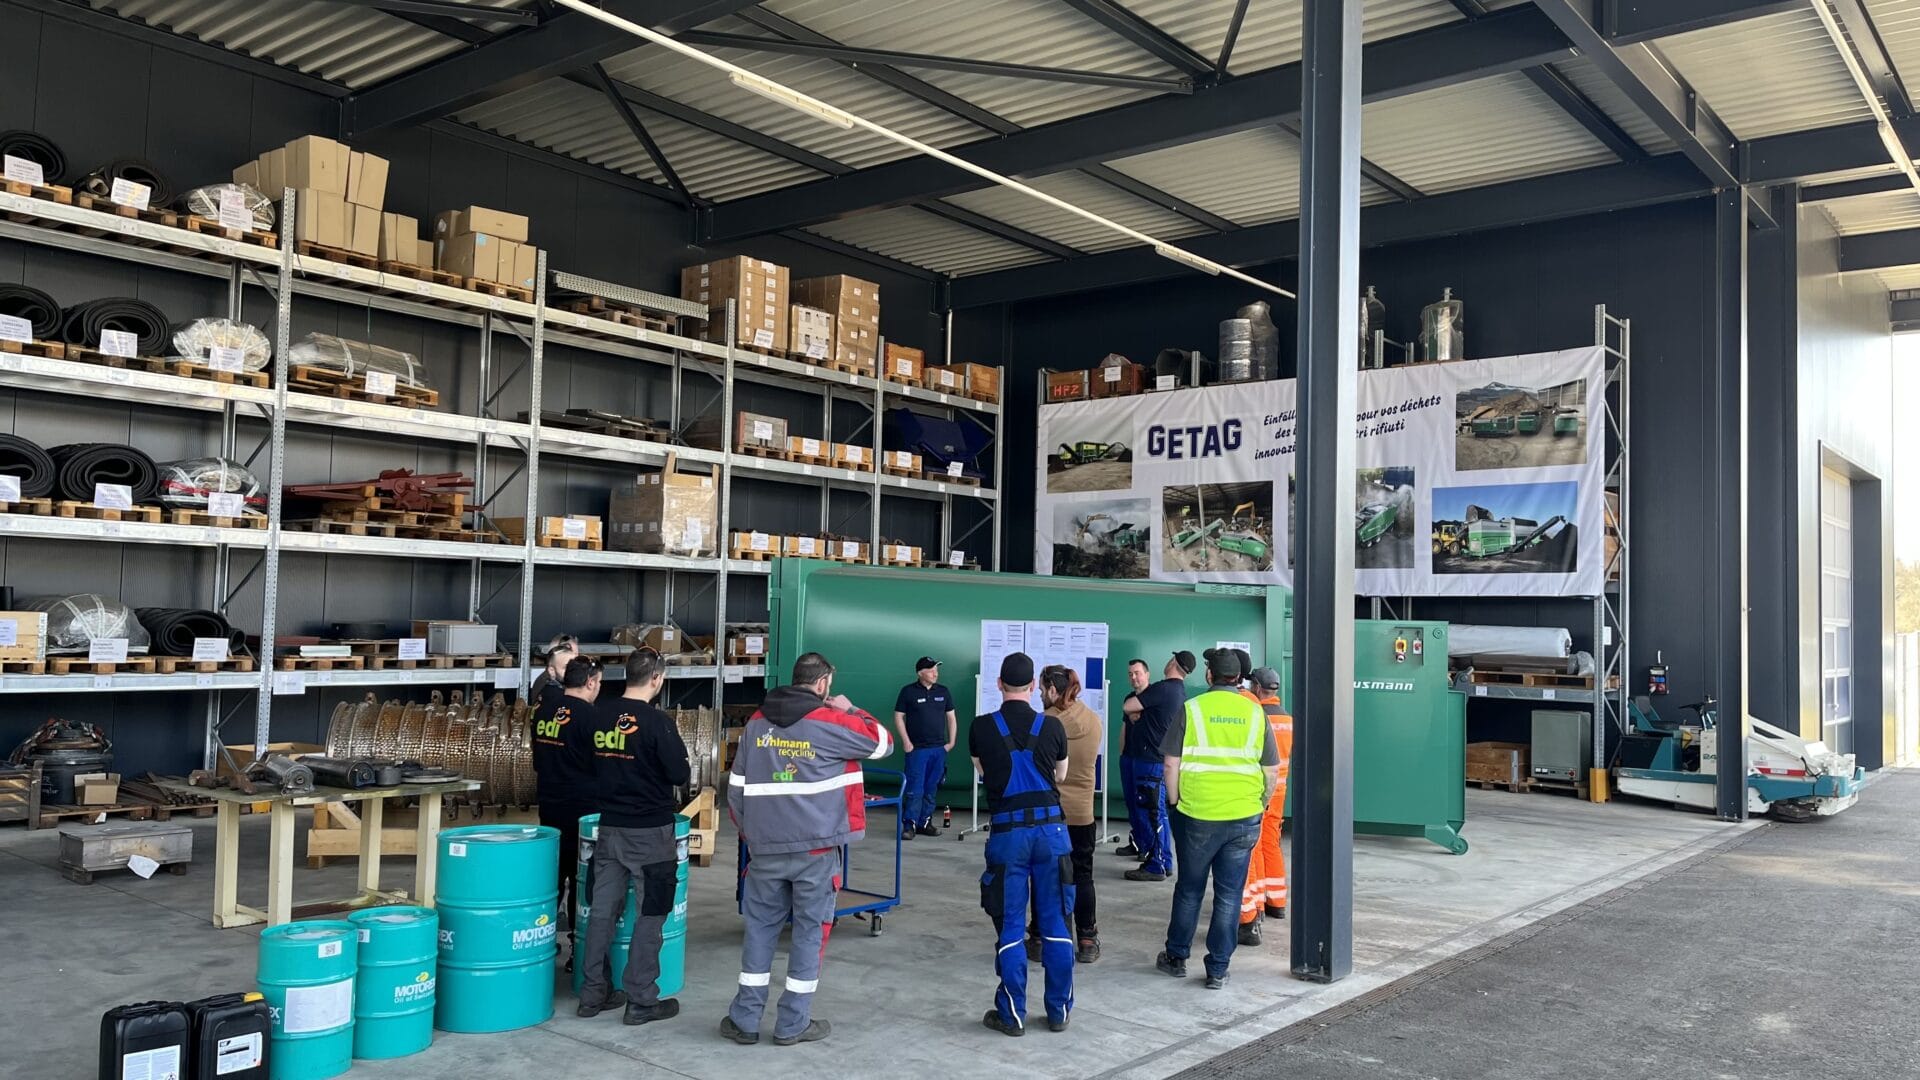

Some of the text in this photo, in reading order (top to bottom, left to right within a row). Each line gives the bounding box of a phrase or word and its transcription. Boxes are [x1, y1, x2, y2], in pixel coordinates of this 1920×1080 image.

[1381, 406, 1398, 417] vos
[1400, 395, 1441, 413] déchets
[1263, 410, 1297, 426] Einfäll
[1275, 428, 1291, 439] des
[1370, 419, 1405, 437] rifiuti
[1148, 418, 1242, 460] GETAG
[1254, 442, 1297, 460] innovazi
[1353, 681, 1413, 691] usmann
[536, 717, 561, 738] edi
[1210, 715, 1246, 725] KÄPPELI
[593, 726, 626, 750] edi
[778, 748, 816, 759] recycling
[772, 769, 793, 781] edi
[512, 921, 557, 943] MOTORE
[512, 942, 523, 950] Oil
[394, 976, 435, 997] MOTORE
